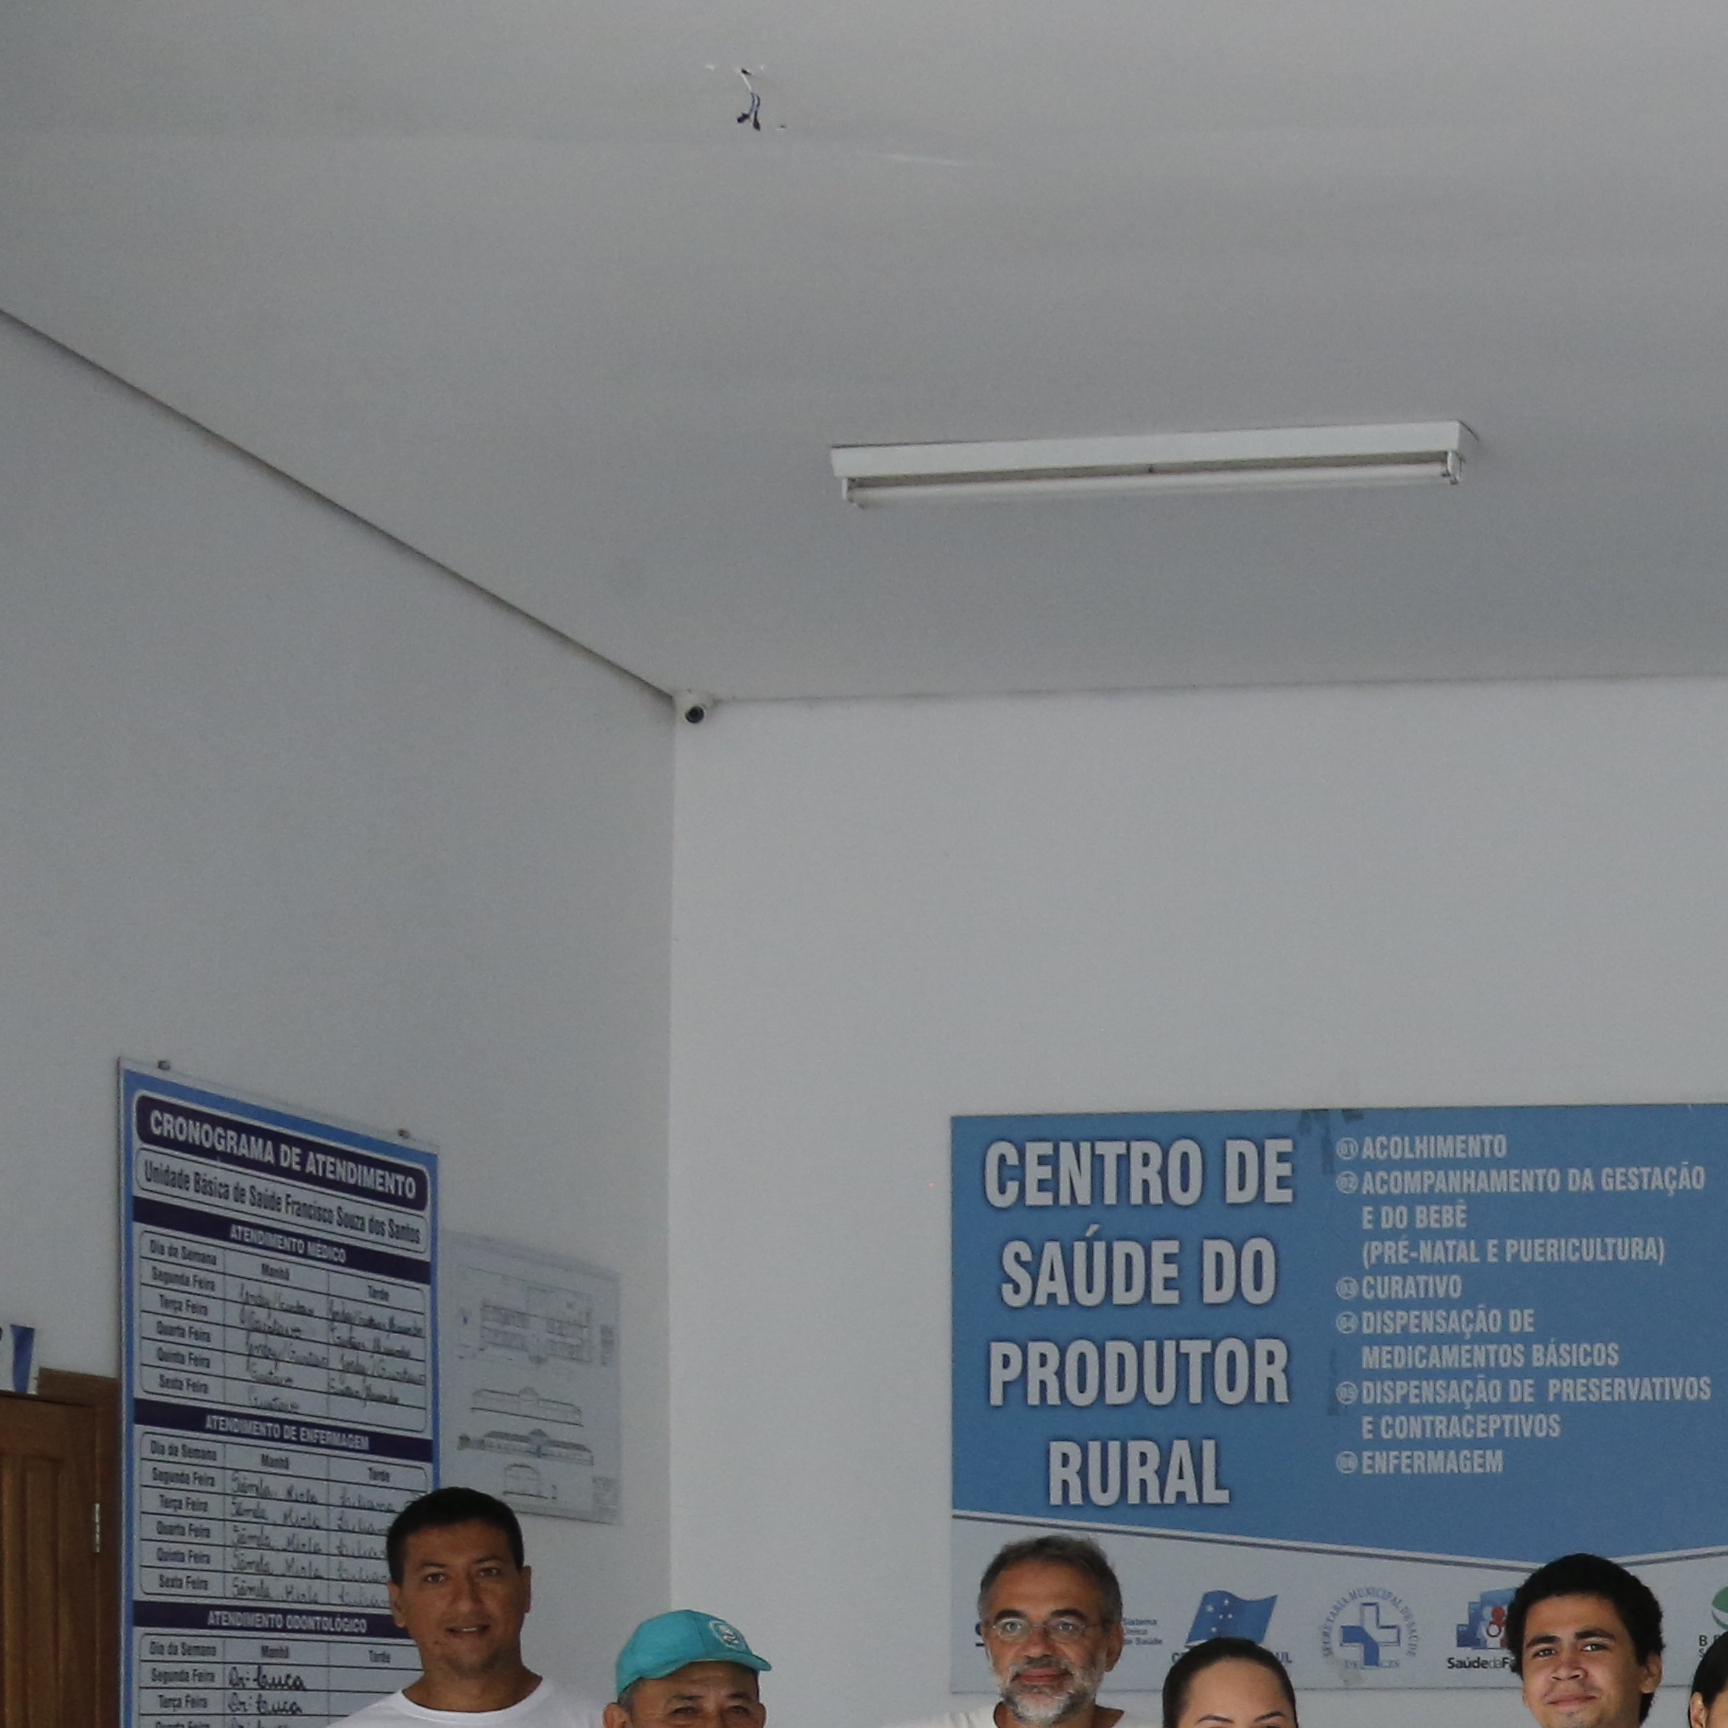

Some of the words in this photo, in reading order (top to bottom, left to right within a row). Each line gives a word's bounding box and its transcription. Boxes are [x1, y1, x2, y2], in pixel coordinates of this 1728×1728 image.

[150, 1109, 275, 1165] CRONOGRAMA
[280, 1143, 302, 1171] DE
[305, 1151, 416, 1199] ATENDIMENTO
[1362, 1134, 1507, 1159] ACOLHIMENTO
[984, 1139, 1202, 1208] CENTRO
[1225, 1139, 1293, 1204] DE
[1362, 1170, 1560, 1195] ACOMPANHAMENTO
[1568, 1168, 1595, 1192] DA
[1601, 1161, 1705, 1196] GESTAÇÃO
[145, 1160, 190, 1191] Unidade
[194, 1171, 230, 1200] Básica
[233, 1182, 245, 1203] de
[249, 1185, 282, 1212] Saúde
[285, 1193, 333, 1224] Francisco
[336, 1205, 365, 1232] Souza
[368, 1214, 386, 1237] dos
[388, 1218, 420, 1244] Santos
[1362, 1206, 1373, 1229] E
[1381, 1205, 1408, 1229] DO
[1416, 1200, 1467, 1228] BEBÊ
[229, 1223, 304, 1254] ATENDIMENTO
[307, 1237, 347, 1263] MÉDICO
[1363, 1235, 1480, 1266] (PRÉ-NATAL
[1488, 1239, 1498, 1262] E
[1506, 1237, 1665, 1265] PUERICULTURA)
[1001, 1225, 1180, 1306] SAÚDE
[1202, 1237, 1276, 1305] DO
[1362, 1275, 1462, 1300] CURATIVO
[1362, 1305, 1501, 1339] DISPENSAÇÃO
[1509, 1309, 1534, 1332] DE
[1362, 1343, 1525, 1369] MEDICAMENTOS
[1532, 1338, 1619, 1367] BÁSICOS
[989, 1338, 1289, 1406] PRODUTOR
[1362, 1376, 1501, 1409] DISPENSAÇÃO
[1509, 1380, 1534, 1402] DE
[1548, 1377, 1711, 1401] PRESERVATIVOS
[206, 1414, 281, 1438] ATENDIMENTO
[283, 1424, 297, 1441] DE
[300, 1426, 369, 1450] ENFERMAGEM
[1362, 1416, 1373, 1439] E
[1381, 1414, 1561, 1439] CONTRACEPTIVOS
[1048, 1439, 1230, 1506] RURAL
[1362, 1450, 1503, 1474] ENFERMAGEM
[207, 1610, 283, 1628] ATENDIMENTO
[286, 1612, 367, 1633] ODONTOLÓGICO
[192, 1669, 215, 1683] Feira
[185, 1695, 208, 1708] Feira
